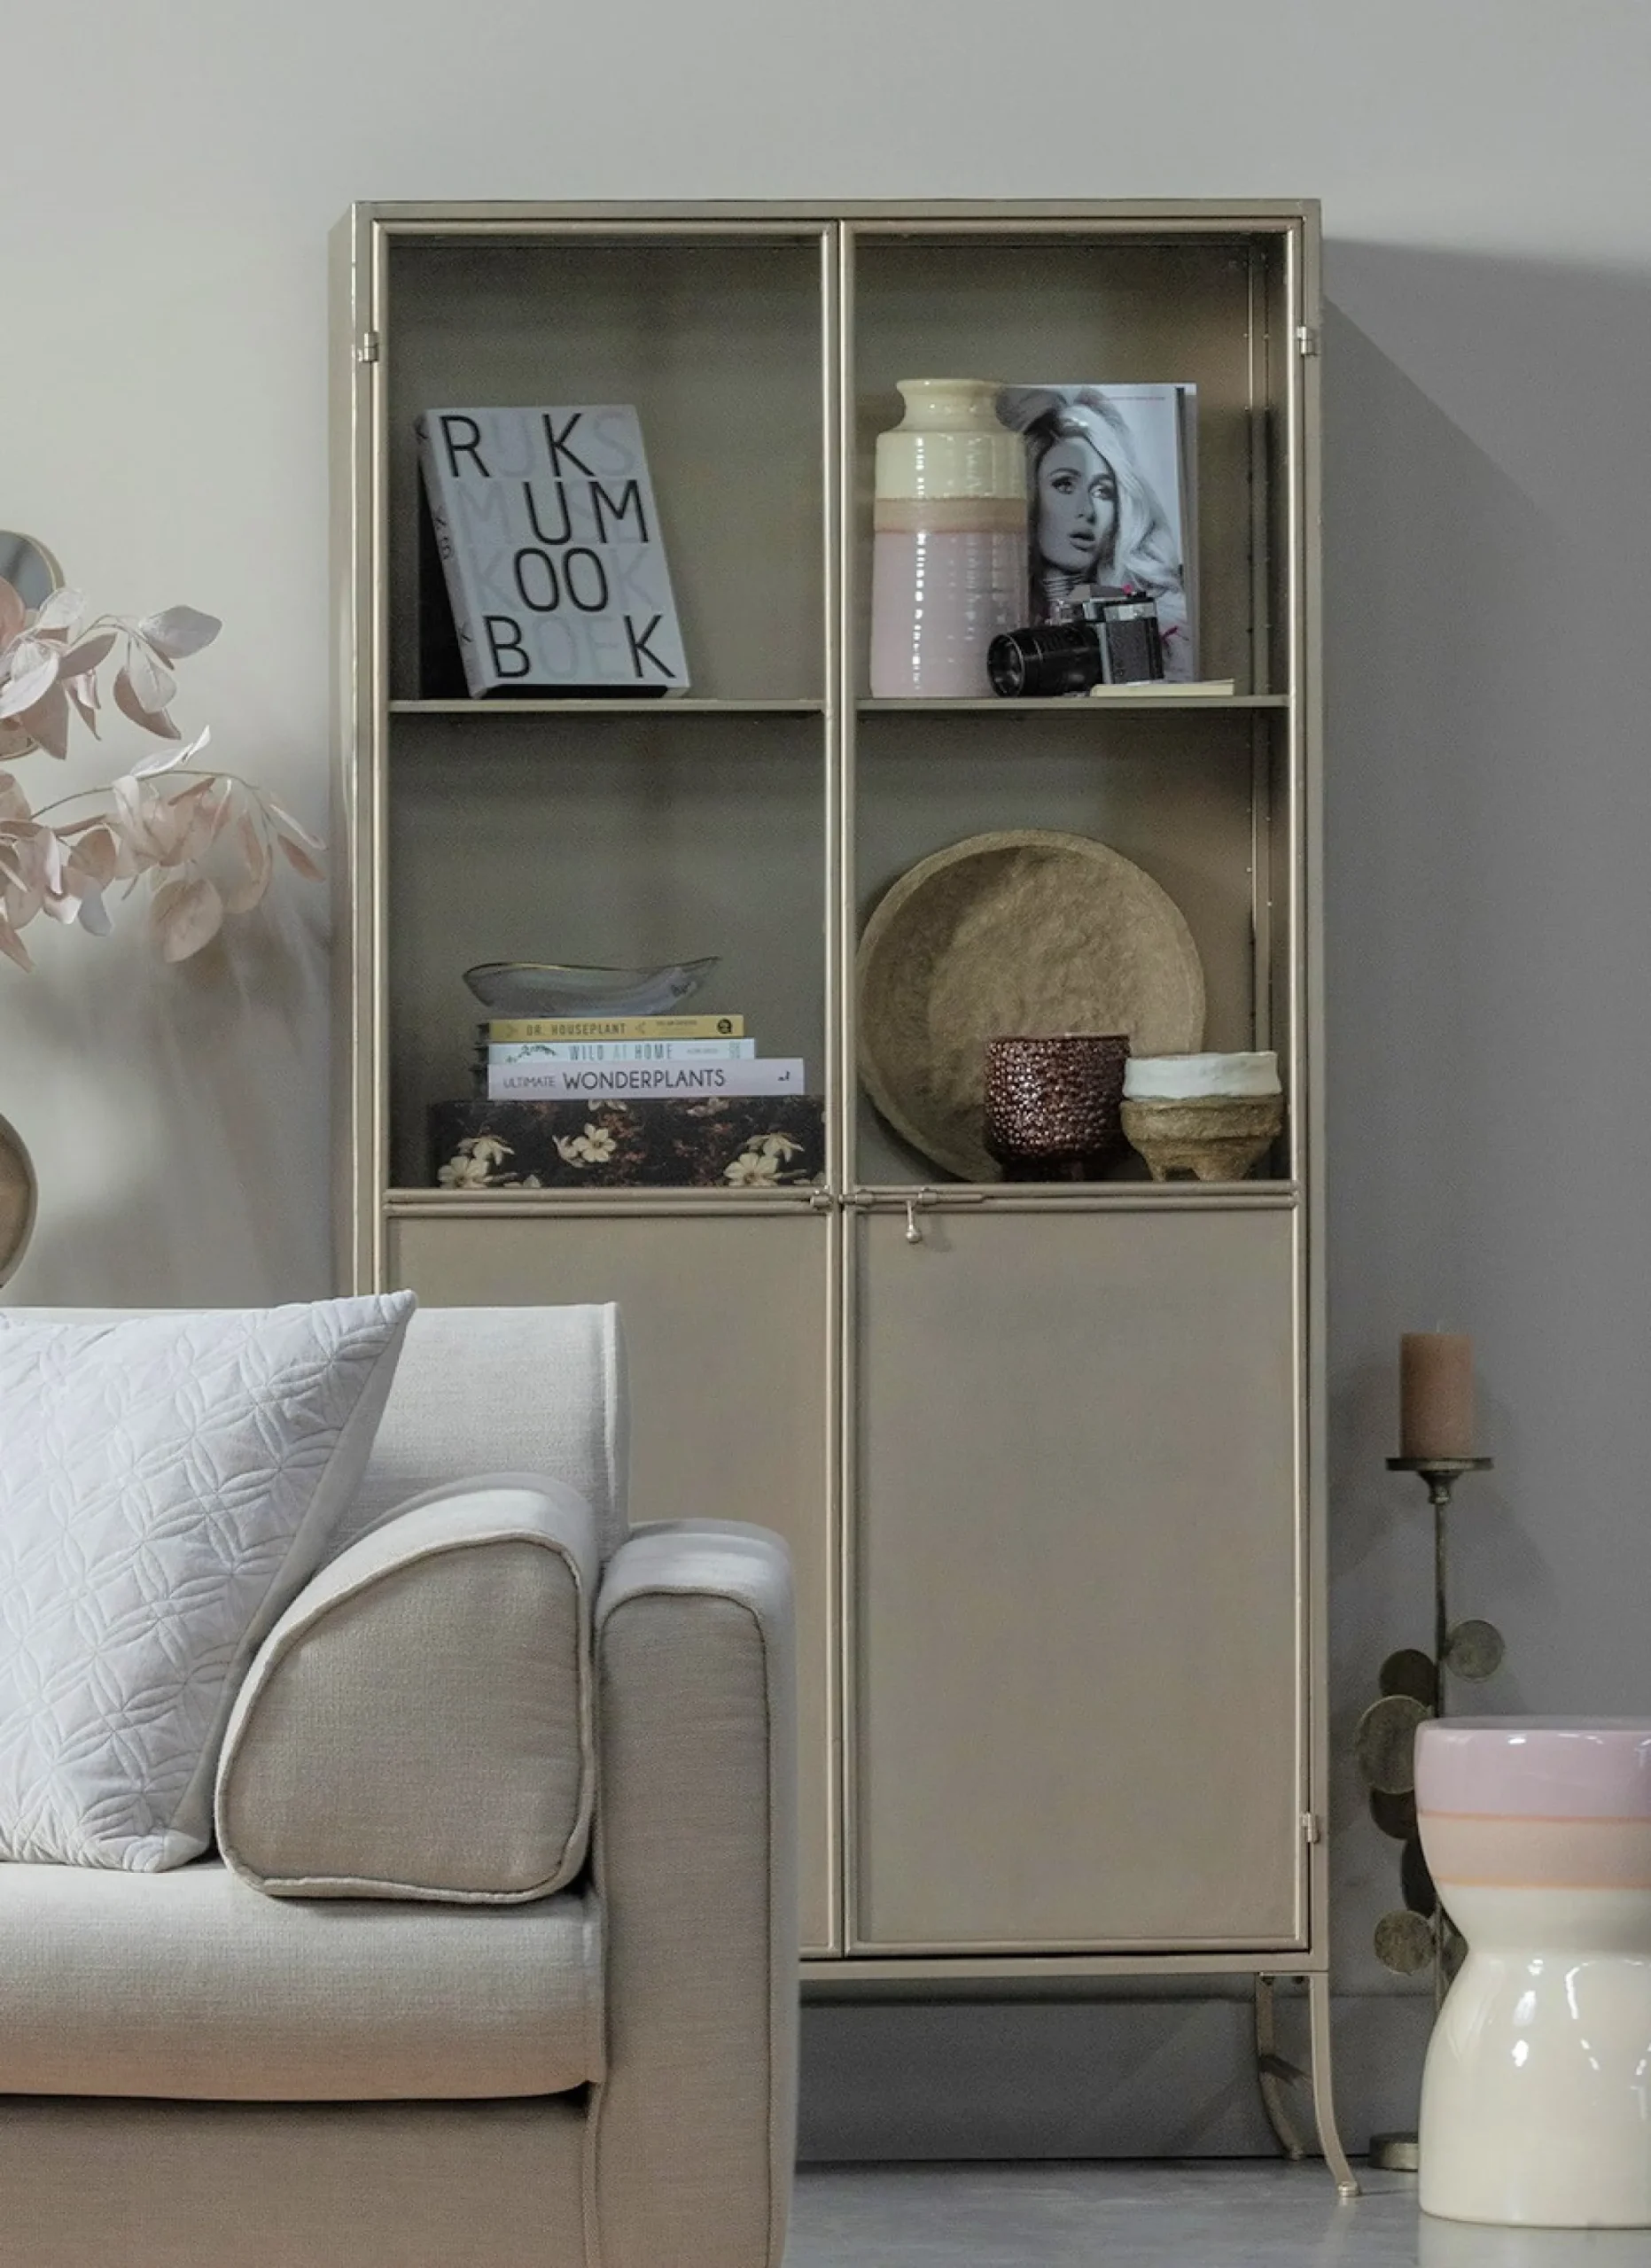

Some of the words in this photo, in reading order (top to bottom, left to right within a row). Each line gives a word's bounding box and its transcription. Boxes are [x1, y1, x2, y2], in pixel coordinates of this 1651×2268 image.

[551, 1022, 627, 1035] HOUSEPLANT
[568, 1044, 604, 1060] WILD
[612, 1044, 630, 1060] AT
[635, 1043, 674, 1060] HOME
[502, 1075, 557, 1089] ULTIMATE
[562, 1068, 727, 1091] WONDERPLANTS
